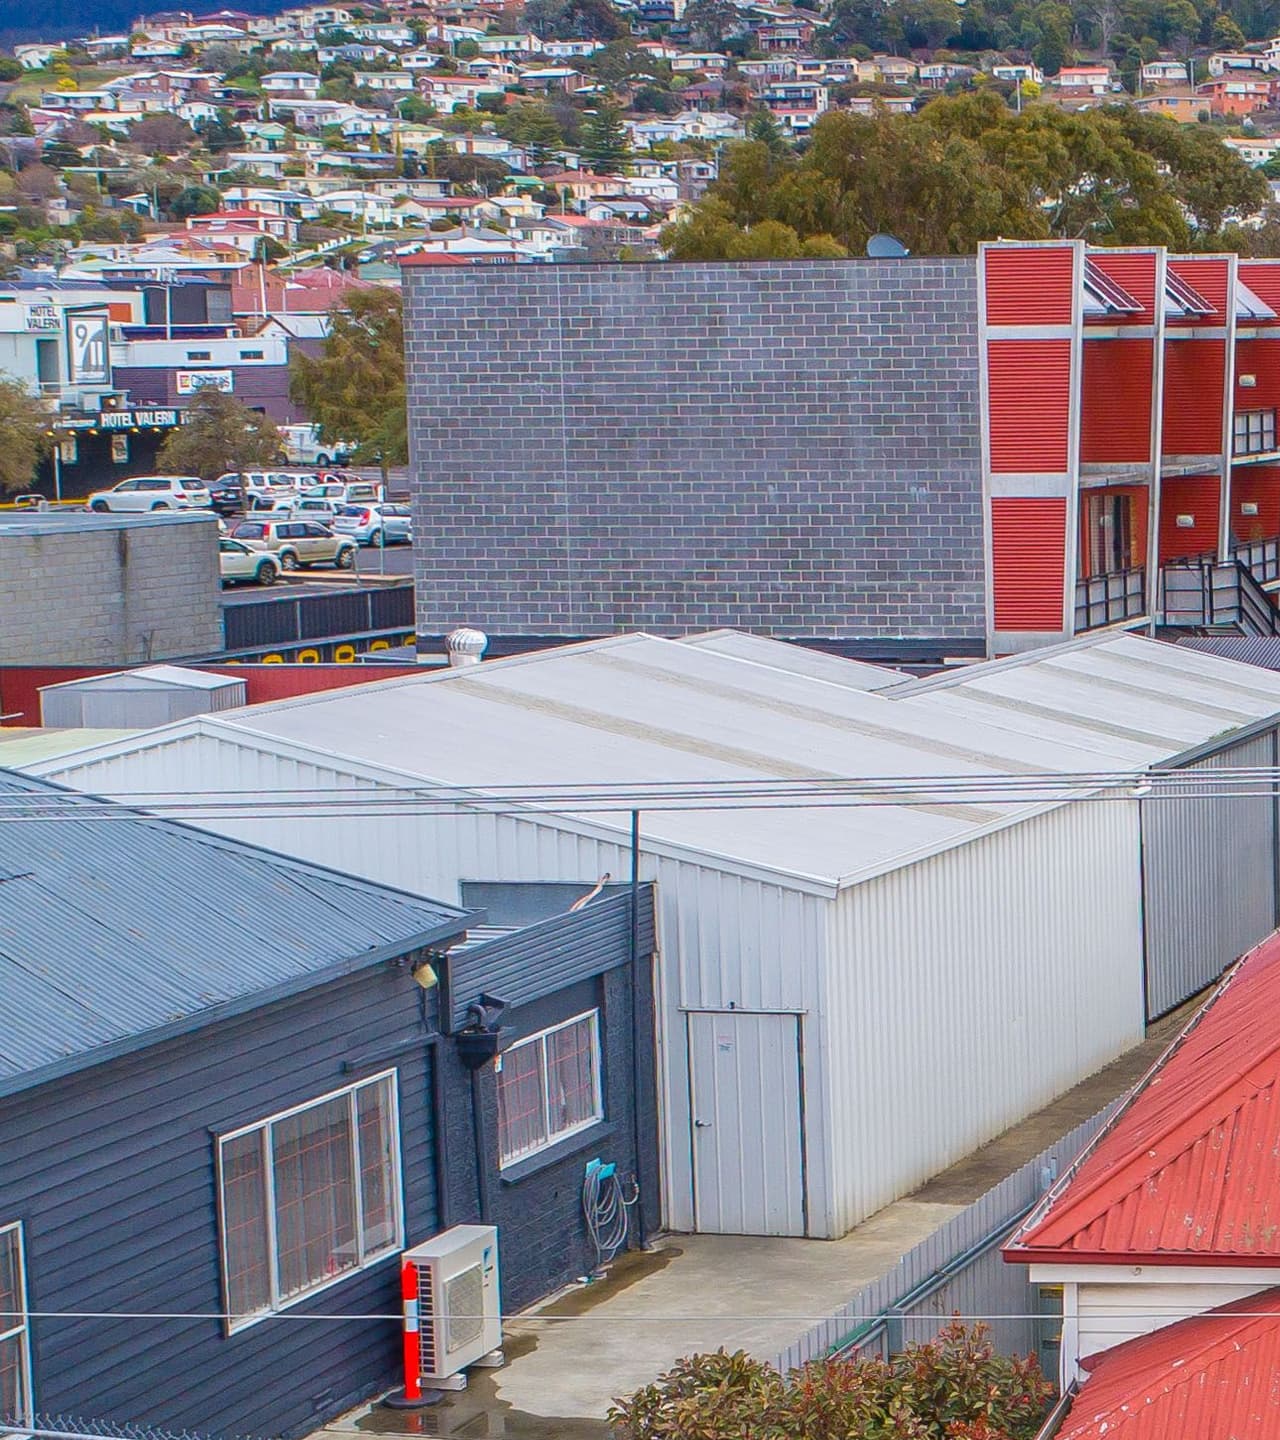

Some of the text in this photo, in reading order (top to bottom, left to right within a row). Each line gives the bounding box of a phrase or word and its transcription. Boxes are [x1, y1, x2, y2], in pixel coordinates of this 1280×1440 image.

[30, 306, 57, 317] HOTEL
[101, 412, 135, 427] HOTEL
[135, 410, 177, 426] VALERN
